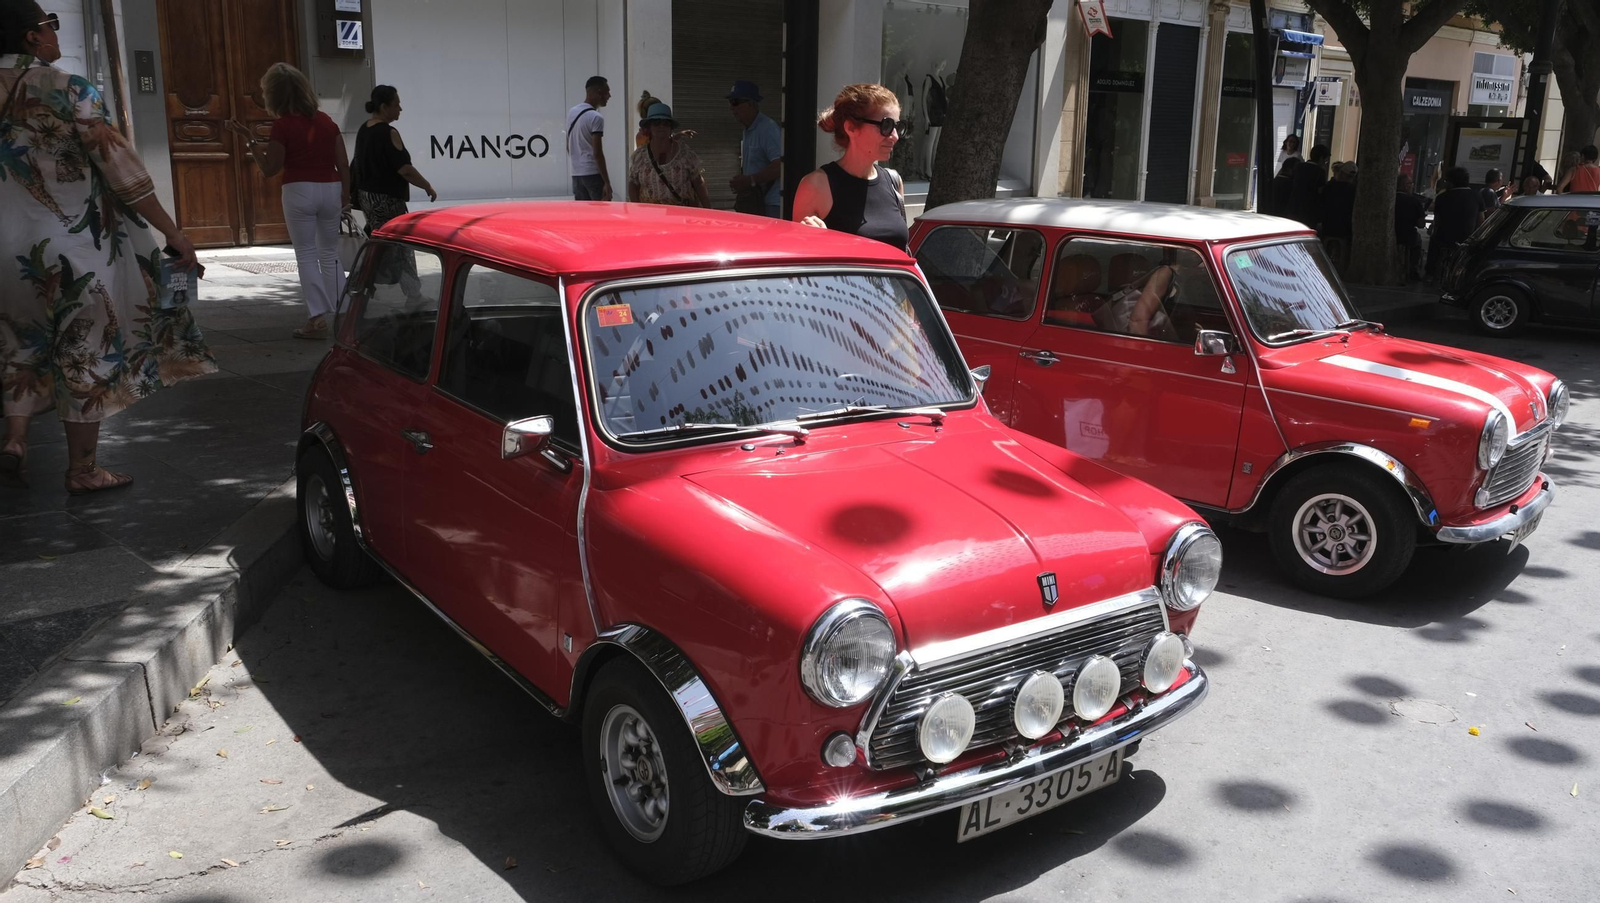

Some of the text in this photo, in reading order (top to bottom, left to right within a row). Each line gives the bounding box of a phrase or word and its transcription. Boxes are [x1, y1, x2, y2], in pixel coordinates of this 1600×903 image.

[1412, 95, 1442, 107] CALZEDONIA
[430, 134, 549, 159] MANGO
[1041, 575, 1055, 587] MINI
